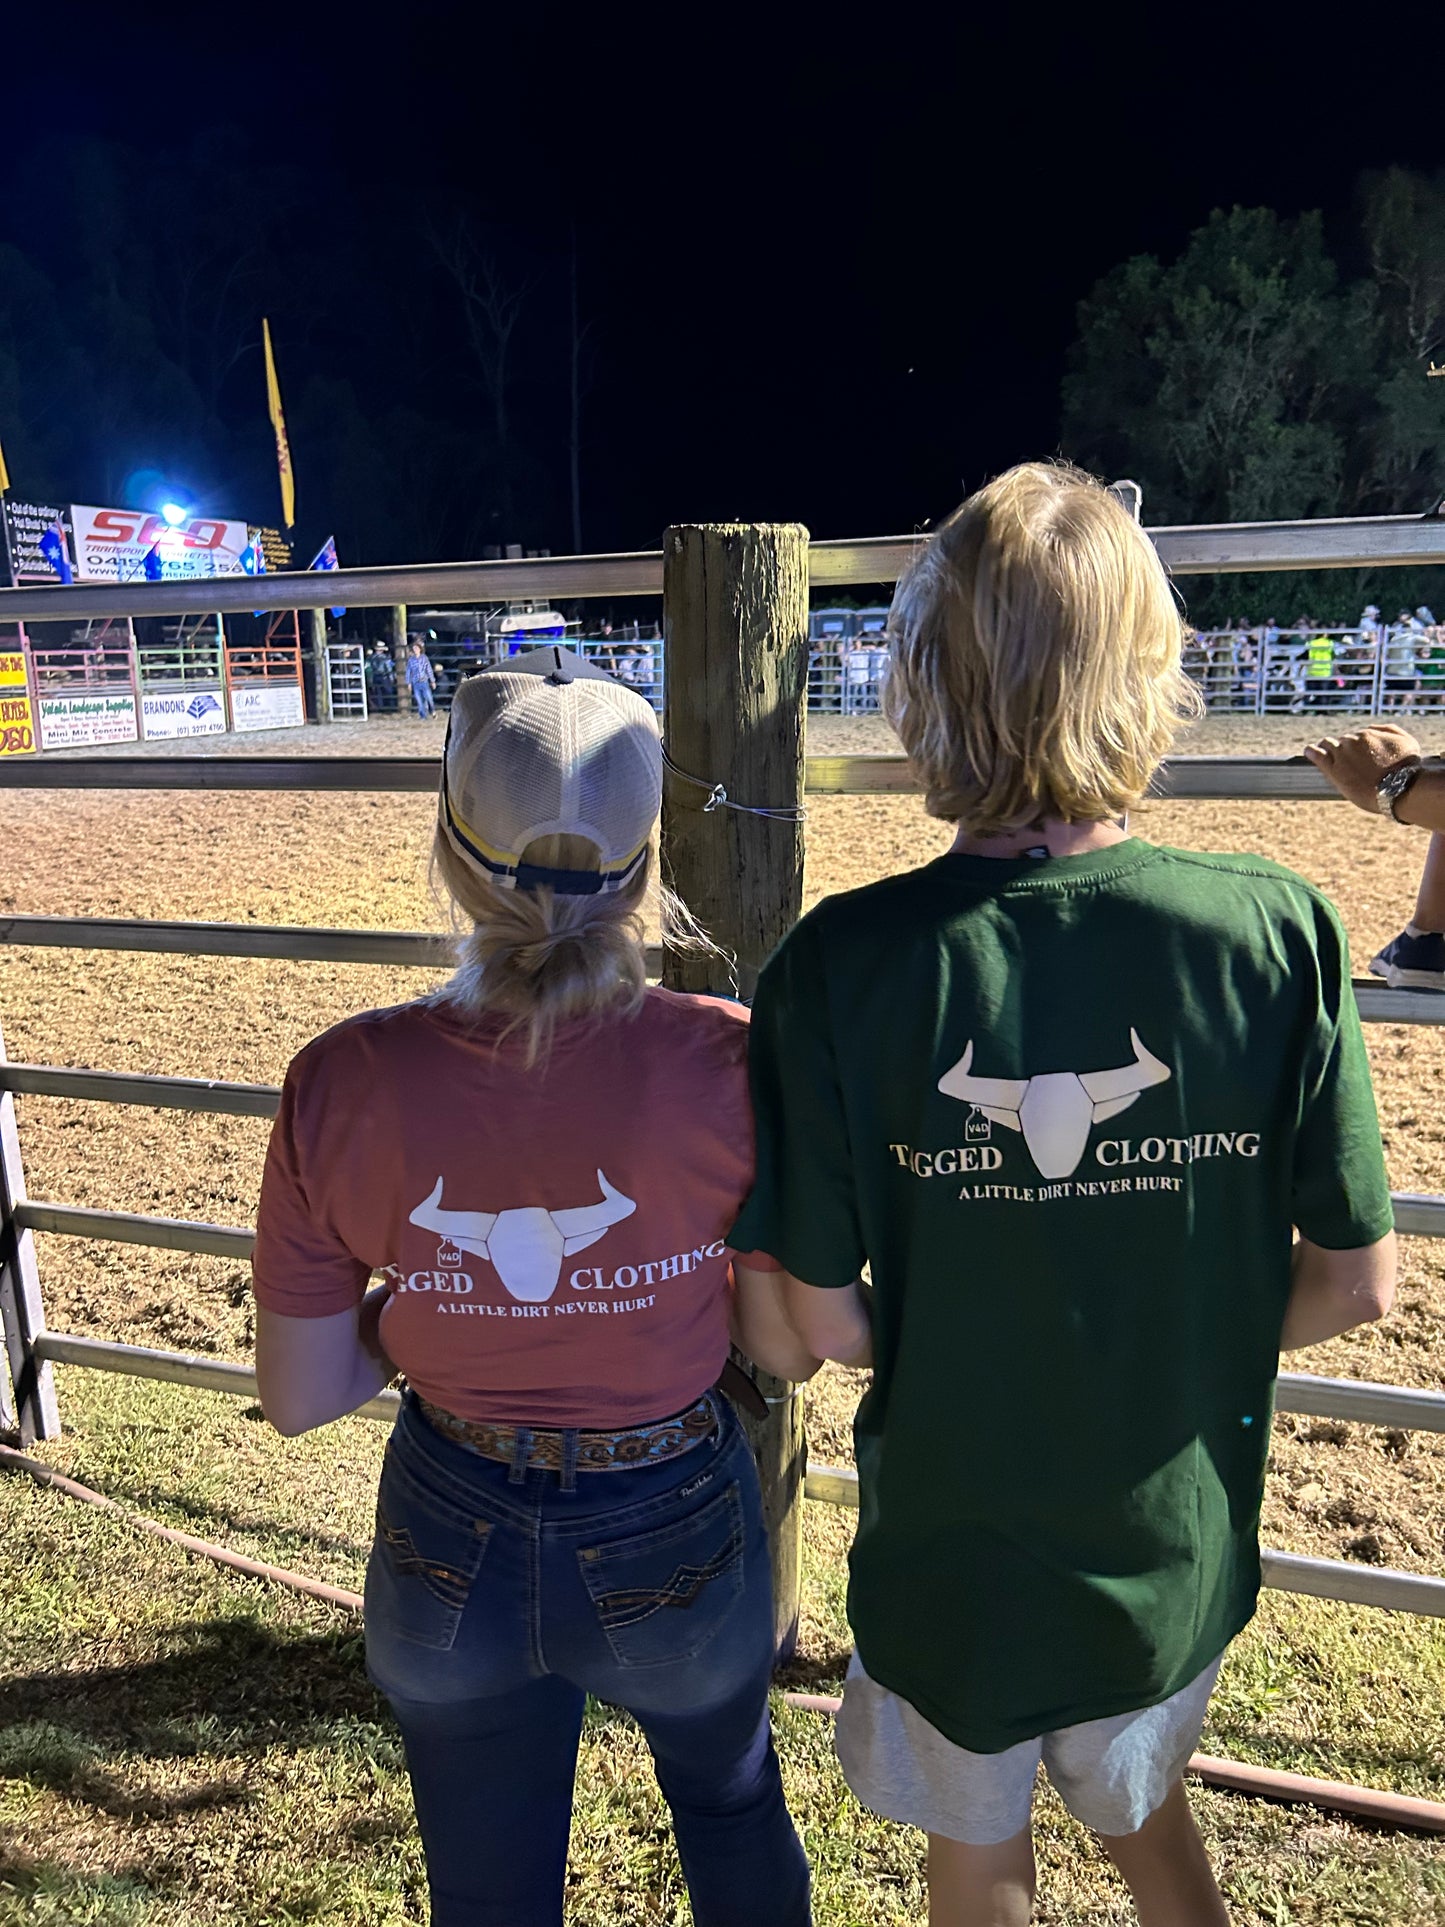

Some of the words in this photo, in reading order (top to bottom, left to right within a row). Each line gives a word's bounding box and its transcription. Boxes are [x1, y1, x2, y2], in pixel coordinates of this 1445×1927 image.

[86, 544, 146, 556] TRANSPOR
[86, 555, 142, 568] 0419
[204, 563, 243, 573] 256
[143, 700, 186, 715] BRANDONS
[47, 730, 69, 738] Mini
[92, 726, 132, 734] Concrete
[889, 1144, 1003, 1178] TGGED
[1095, 1132, 1261, 1167] CLOTHING
[958, 1187, 970, 1200] A
[973, 1184, 1034, 1202] LITTLE
[1038, 1183, 1073, 1202] DIRT
[1075, 1178, 1132, 1197] NEVER
[1135, 1176, 1183, 1192] HURT
[569, 1238, 726, 1291] CLOTHING
[437, 1303, 447, 1313] A
[449, 1303, 507, 1317] LITTLE
[511, 1305, 550, 1318] DIRT
[554, 1301, 609, 1316] NEVER
[613, 1294, 657, 1313] HURT
